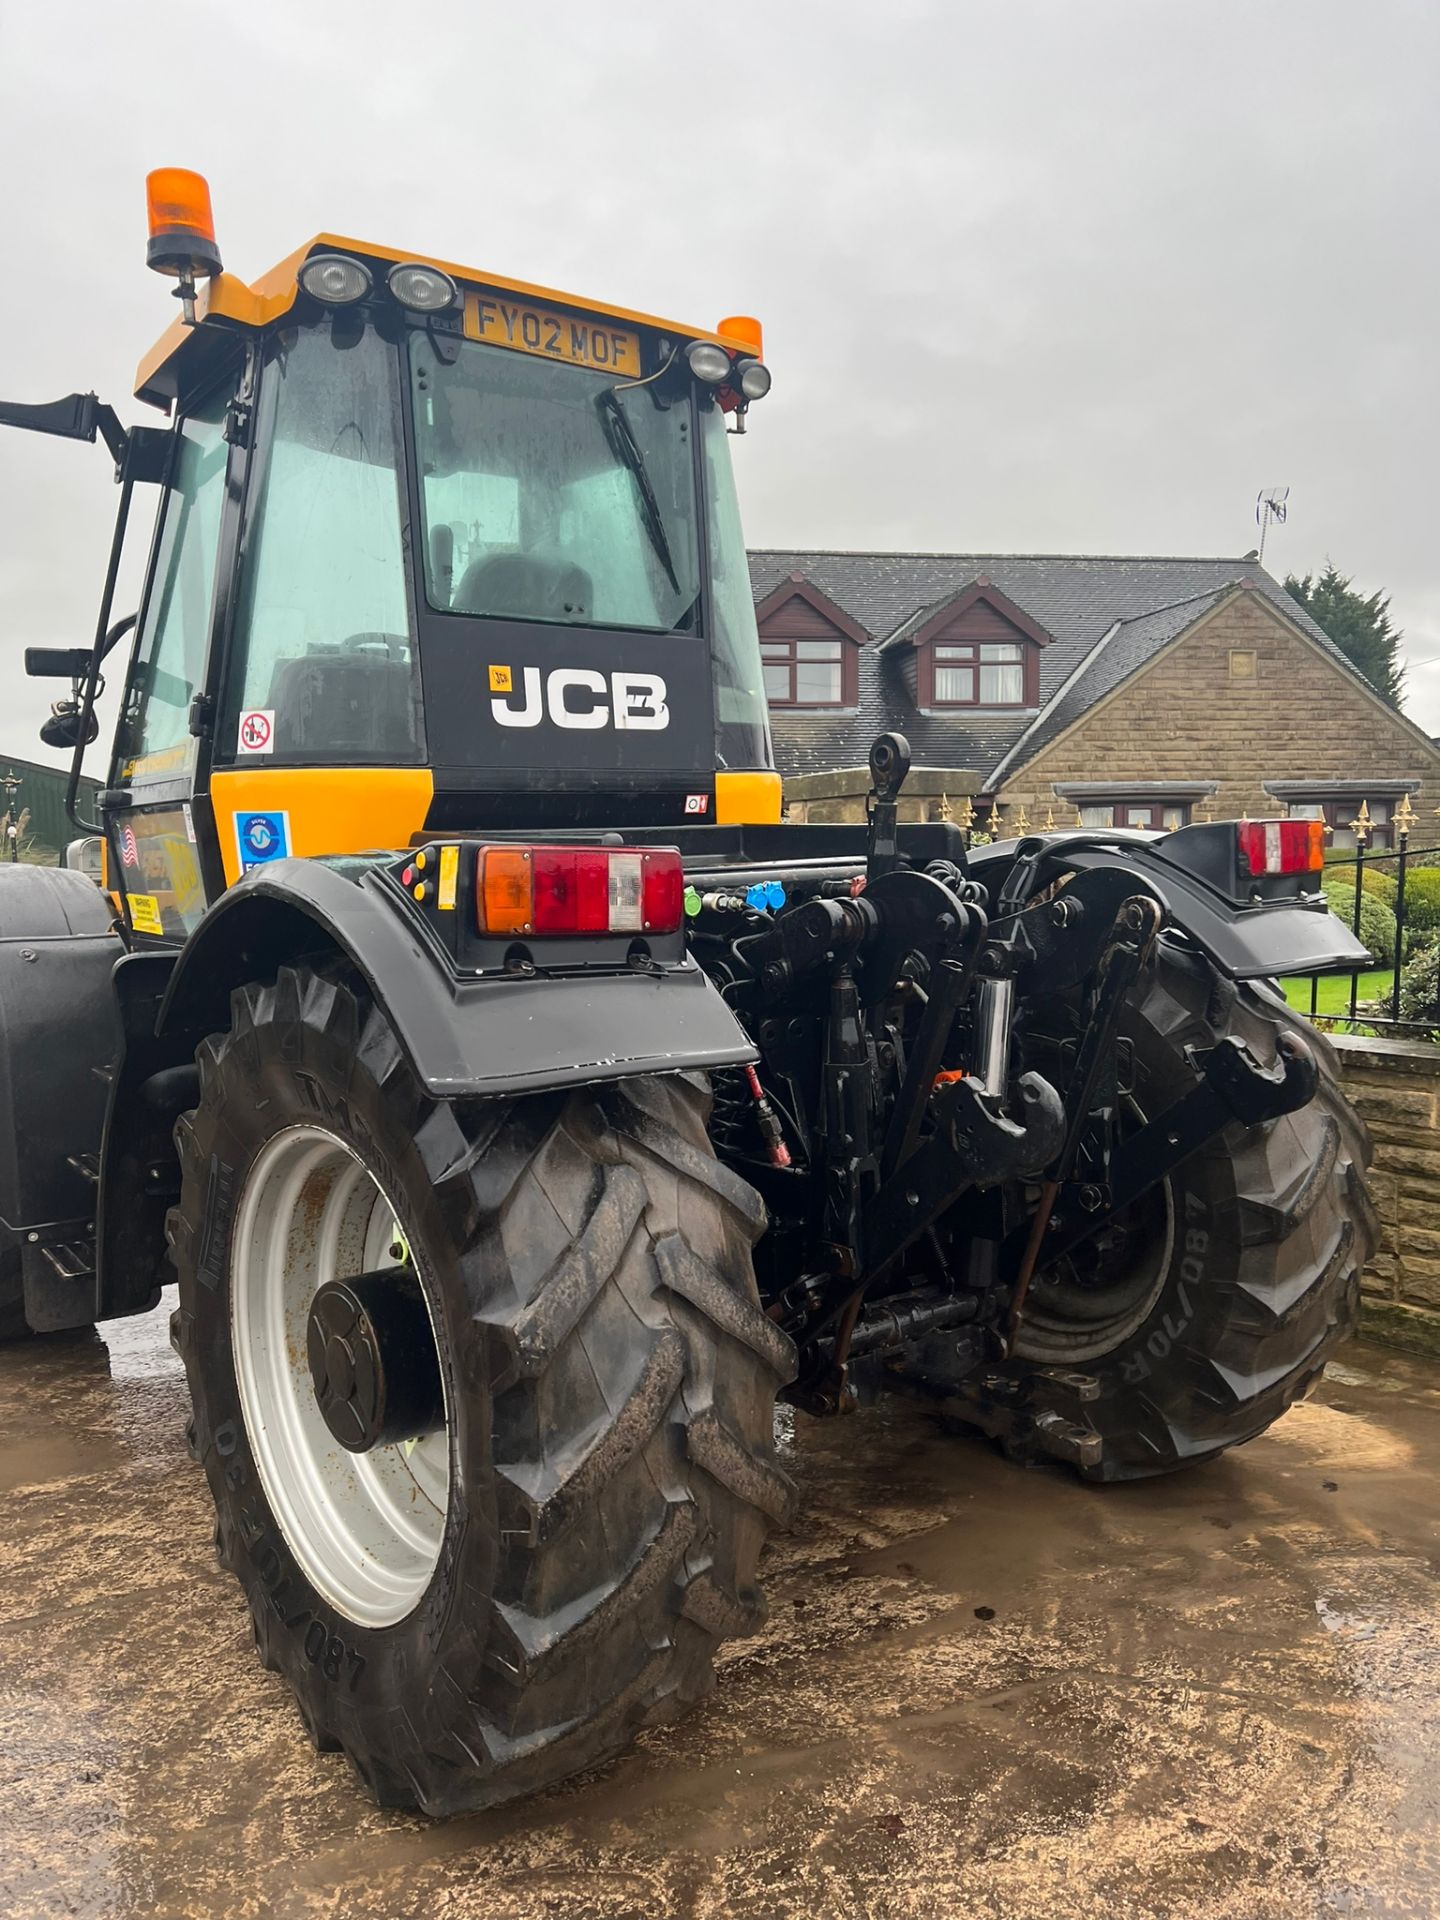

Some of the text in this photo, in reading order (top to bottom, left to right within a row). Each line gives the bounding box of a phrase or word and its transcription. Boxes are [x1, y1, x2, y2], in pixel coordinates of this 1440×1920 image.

[477, 299, 628, 367] FY02 MOF
[490, 666, 670, 730] JCB
